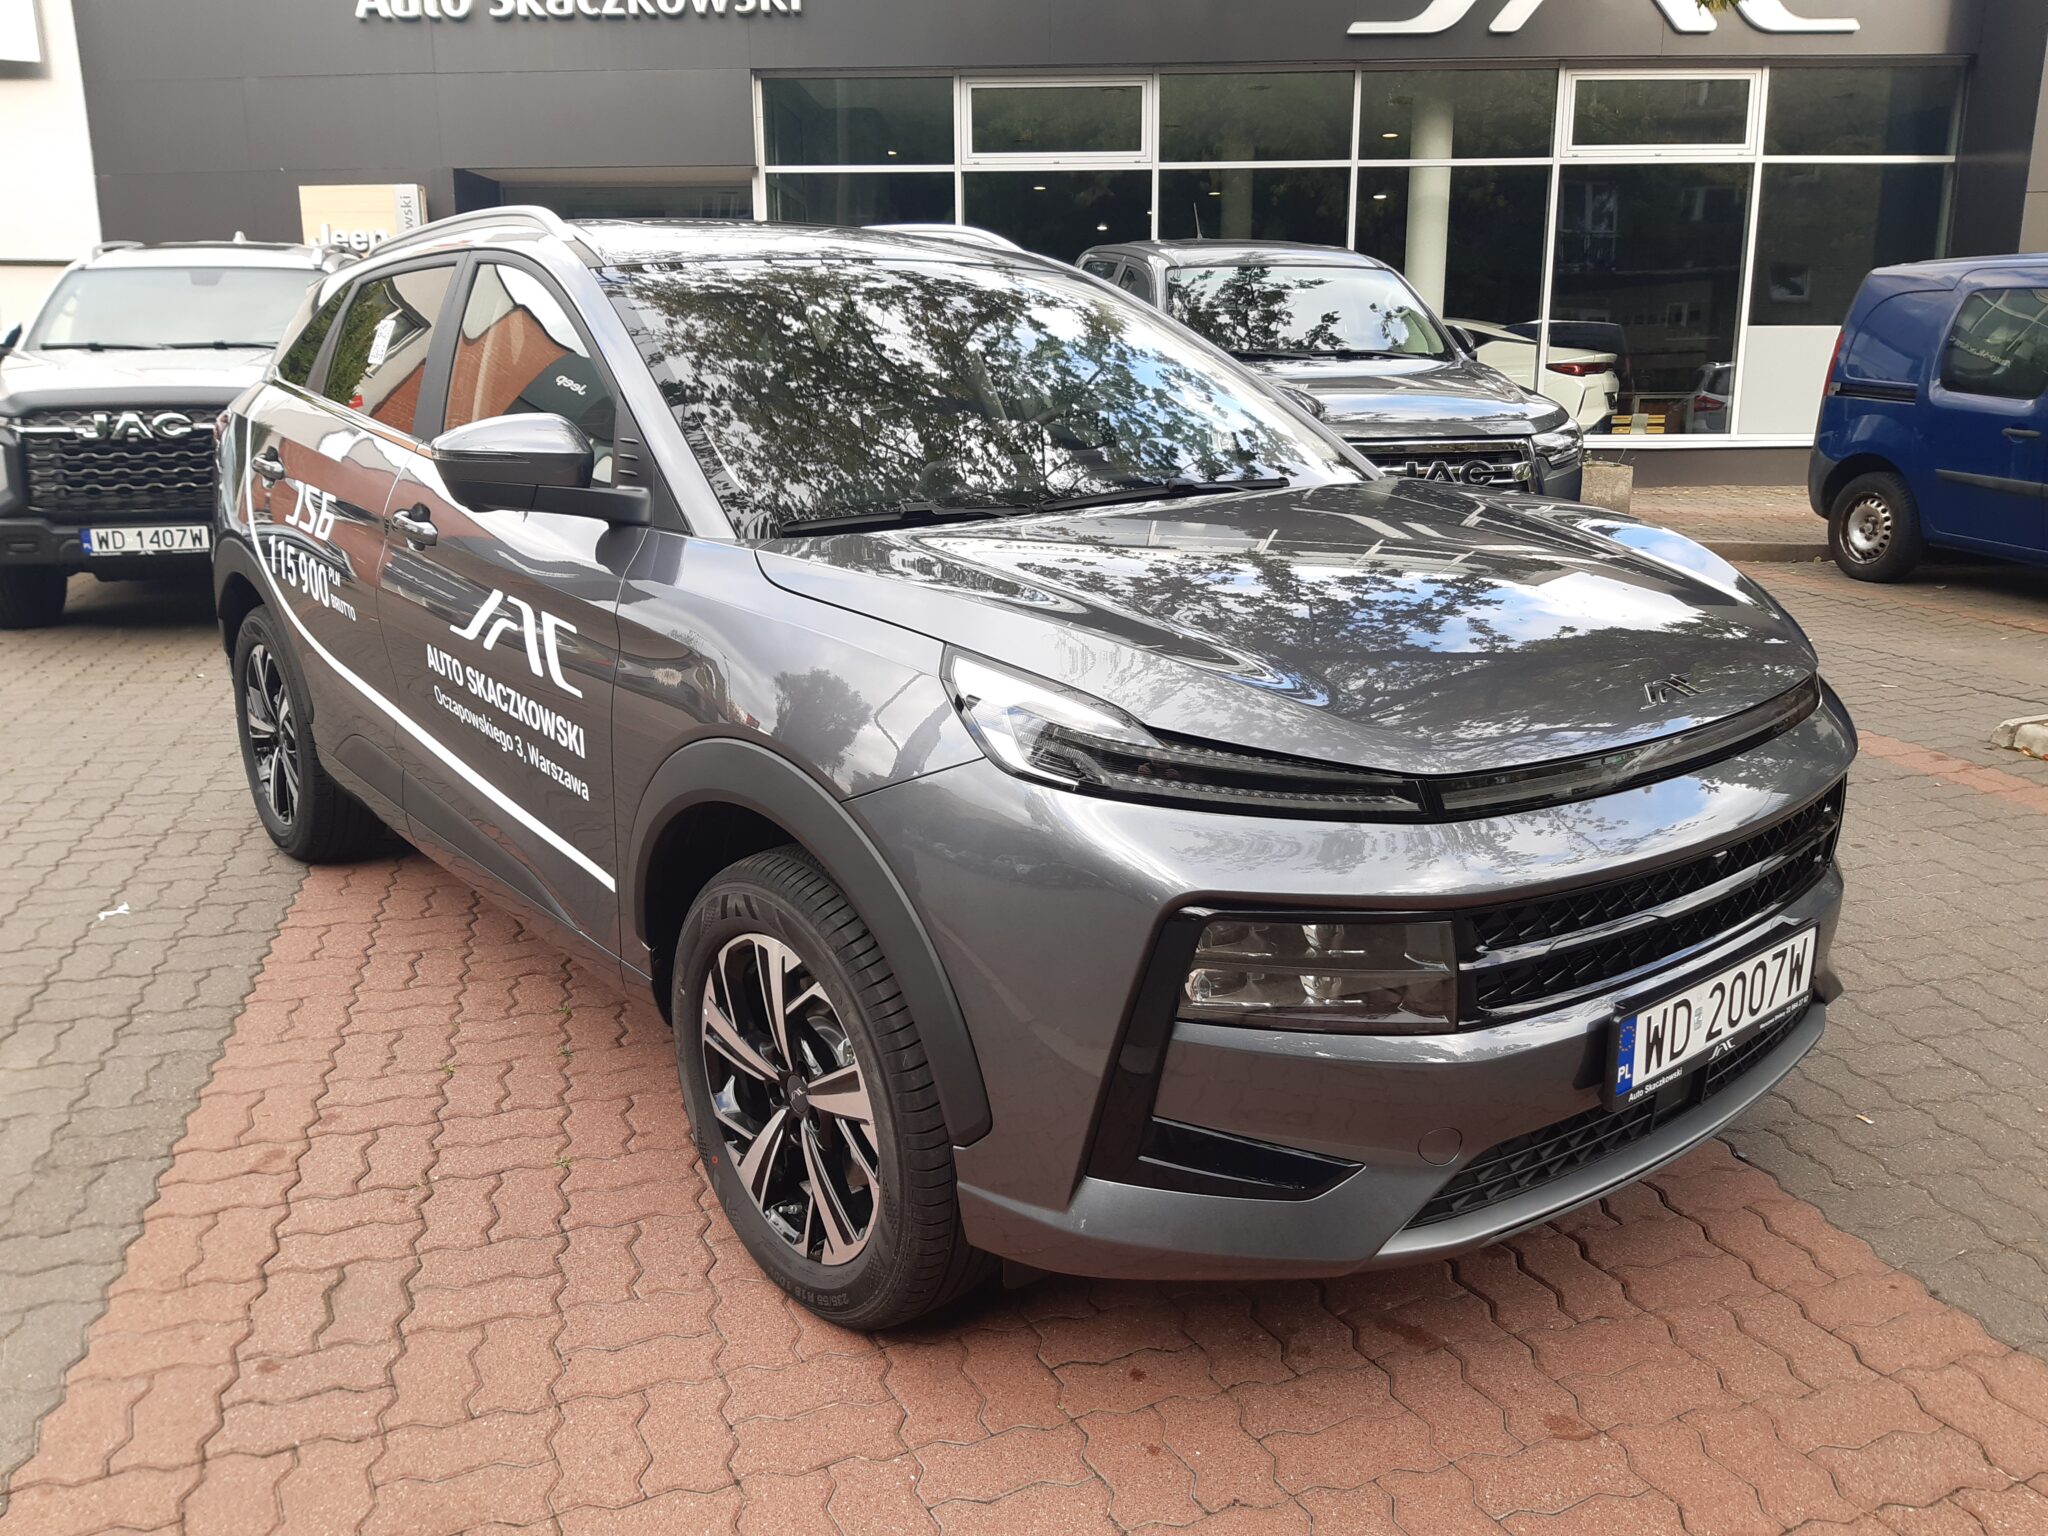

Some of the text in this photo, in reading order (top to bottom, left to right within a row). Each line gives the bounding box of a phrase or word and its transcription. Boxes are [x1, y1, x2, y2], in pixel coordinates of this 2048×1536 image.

[76, 412, 193, 439] JAC
[95, 530, 126, 550] WD
[136, 528, 204, 549] 1407W
[285, 479, 337, 541] JS6
[268, 534, 341, 608] 115 900 PLN
[330, 592, 357, 622] BRUTTO
[450, 588, 583, 698] JAC
[427, 643, 586, 759] AUTO SKACZKOWSKI
[433, 685, 590, 802] Oczapowskiego 3, Warszawa
[1644, 936, 1808, 1076] WD 2007W
[1616, 1063, 1632, 1084] PL
[1627, 1066, 1683, 1103] Auto Skaczkowski
